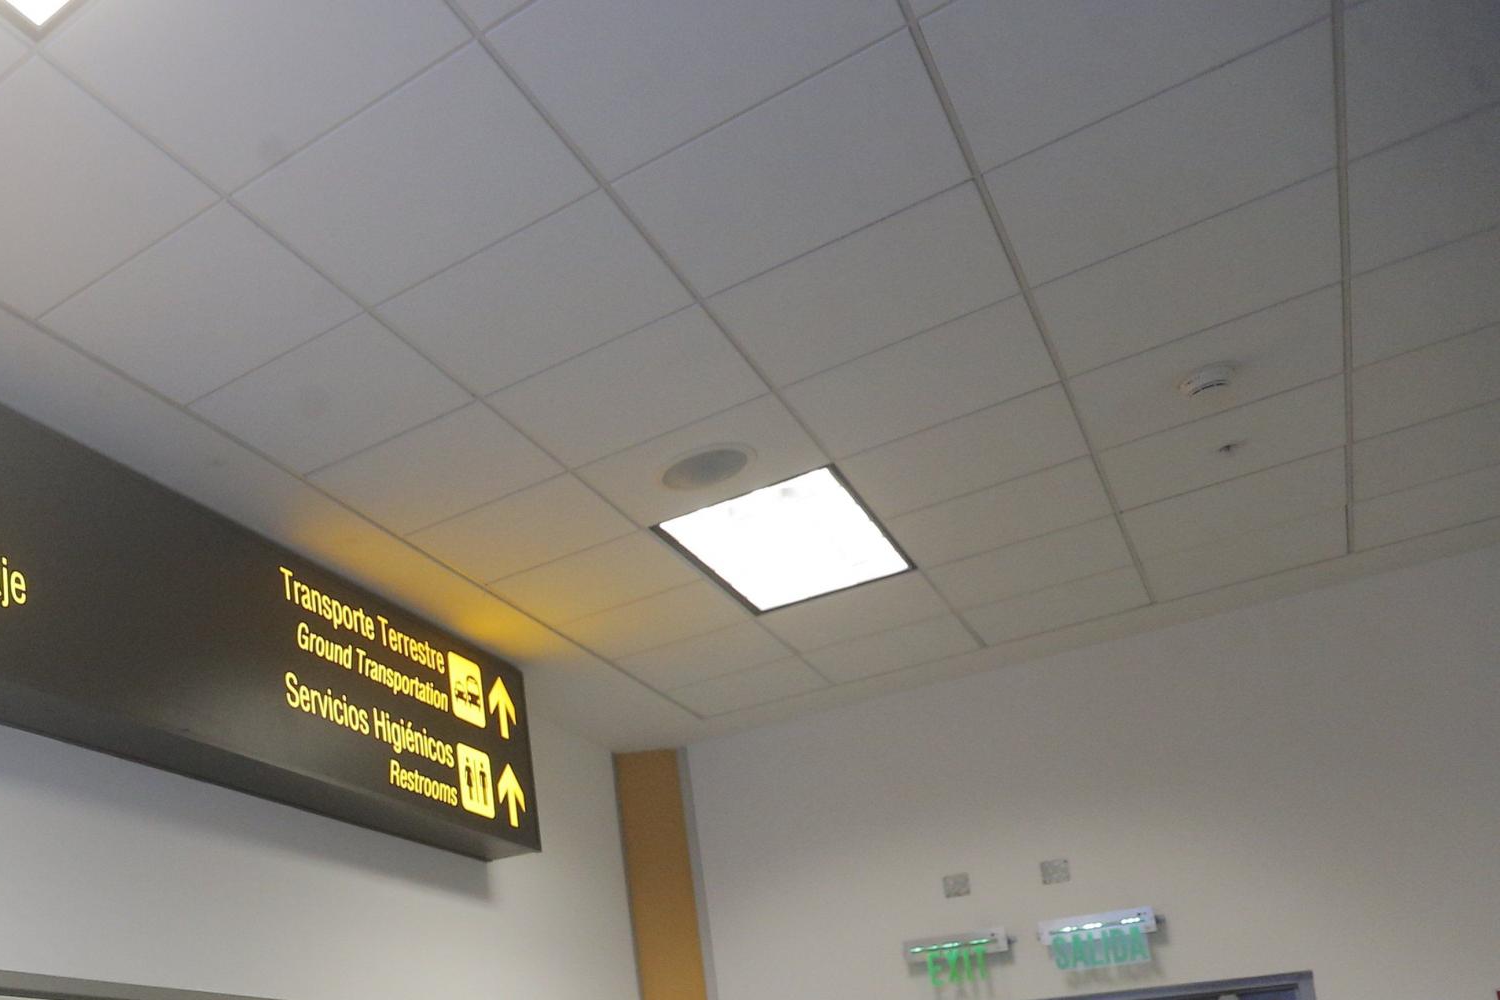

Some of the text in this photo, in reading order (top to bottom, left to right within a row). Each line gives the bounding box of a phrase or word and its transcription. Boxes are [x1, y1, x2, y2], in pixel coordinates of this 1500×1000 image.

[279, 566, 446, 675] Transporte Terrestre
[297, 622, 452, 713] Ground Transportation
[285, 672, 455, 768] Servicios Higiénicos
[389, 759, 458, 807] Restrooms
[927, 946, 989, 988] EXIT
[1051, 926, 1148, 970] SALIDA
